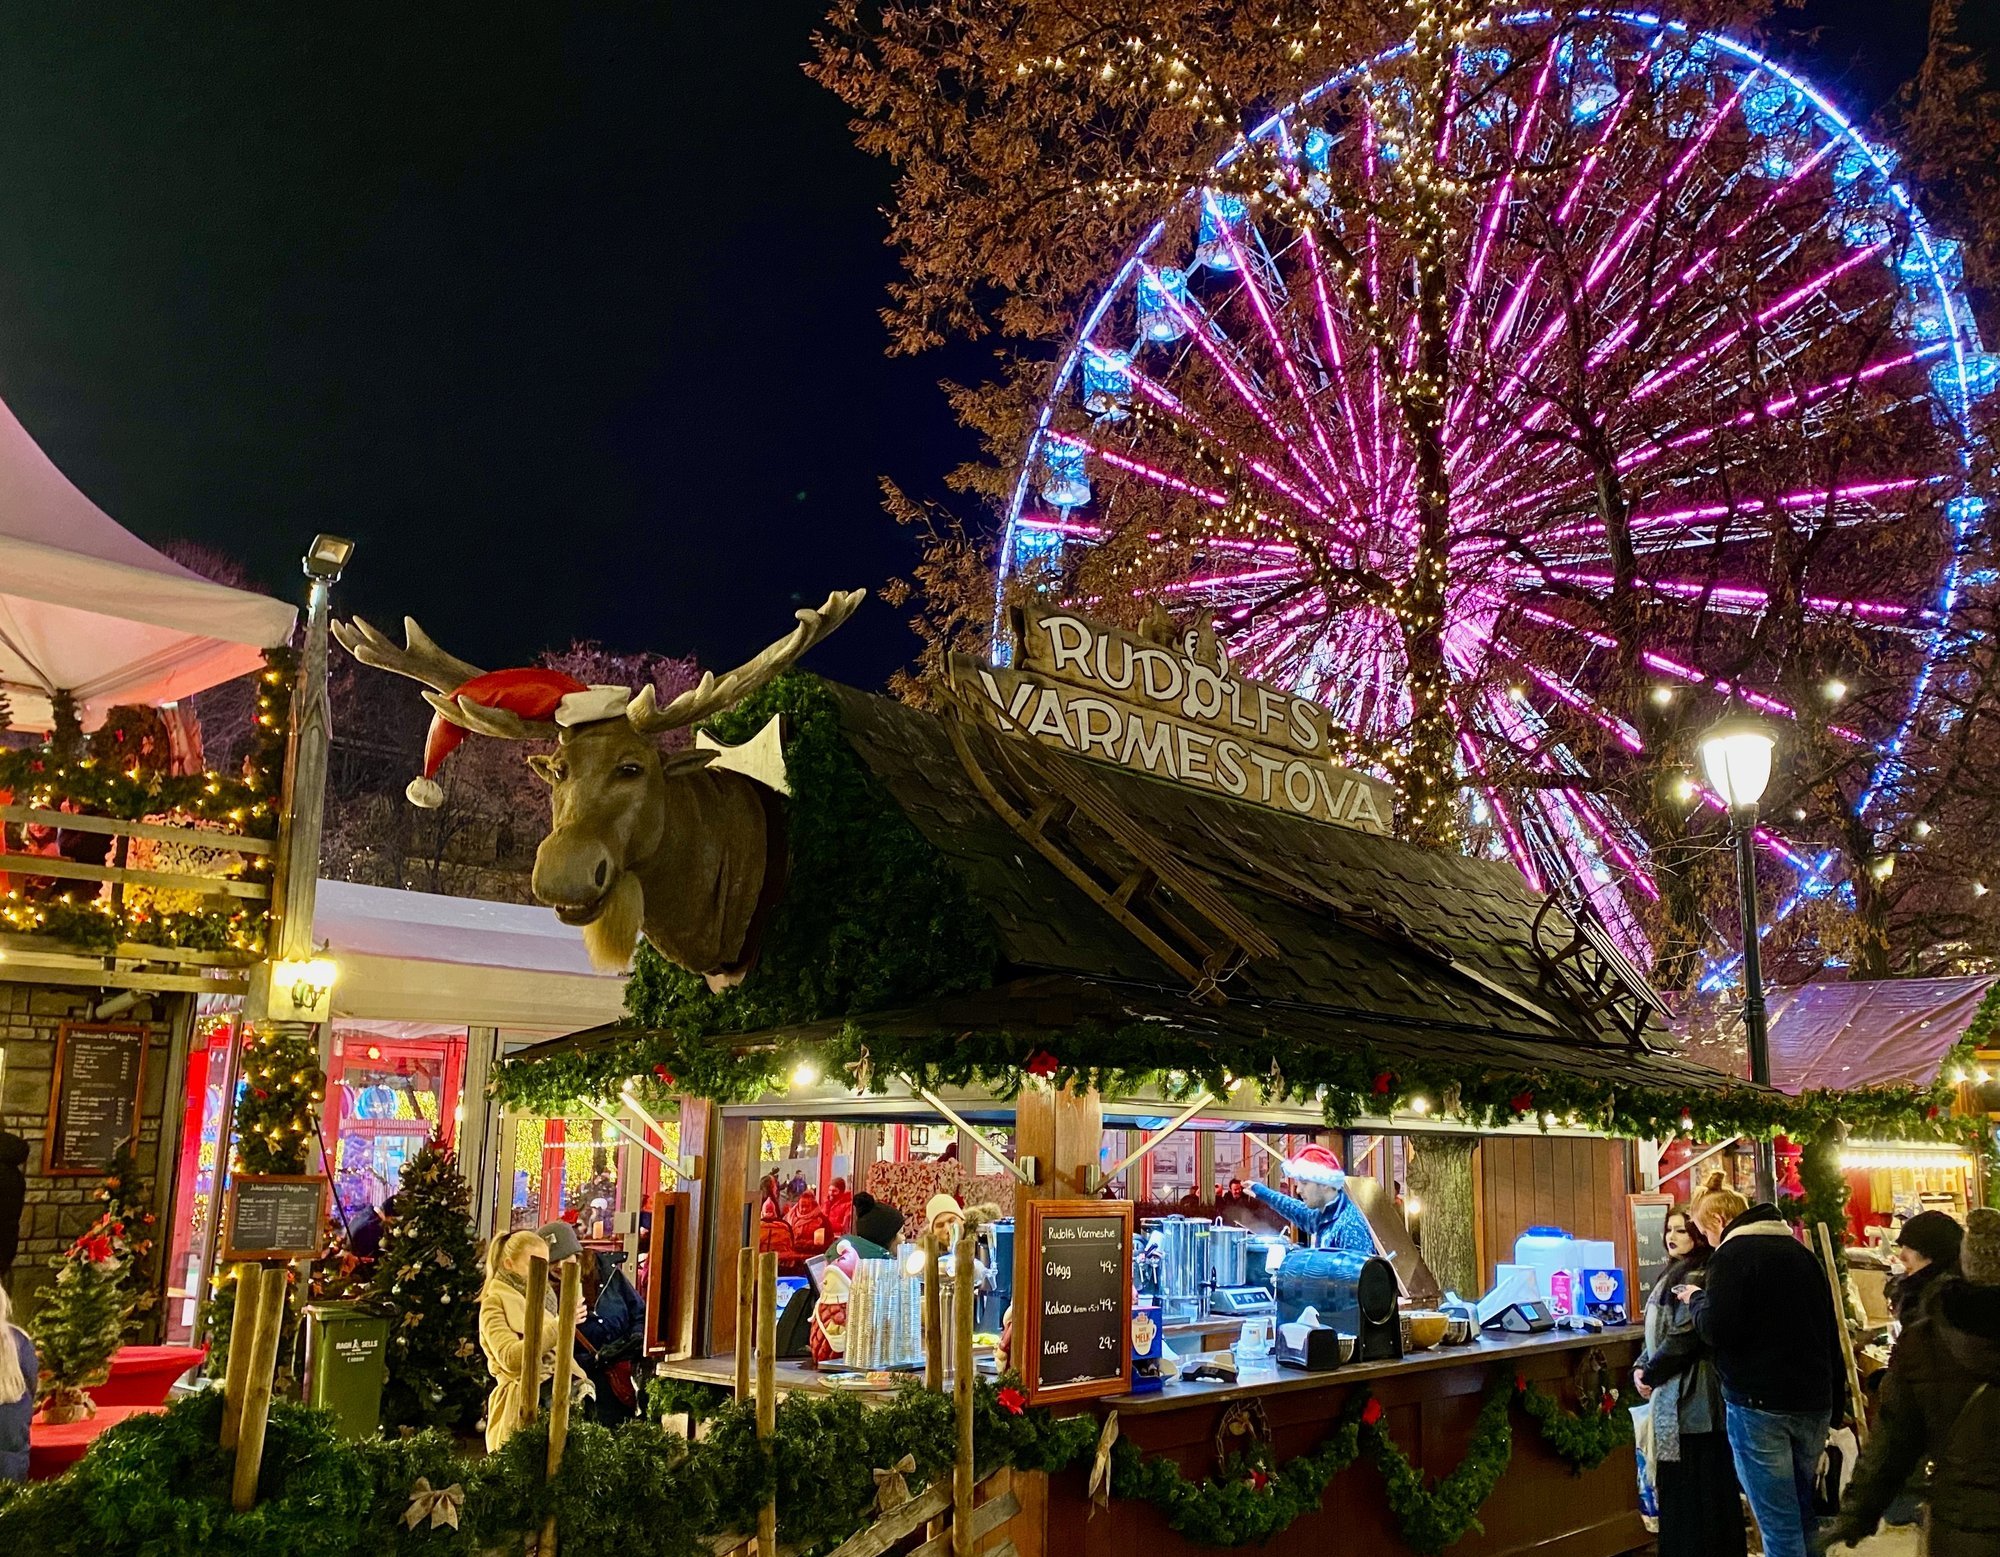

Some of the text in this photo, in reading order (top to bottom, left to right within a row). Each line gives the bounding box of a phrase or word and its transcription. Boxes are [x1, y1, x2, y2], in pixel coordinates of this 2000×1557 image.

[1037, 615, 1320, 750] RUDOLFS
[977, 669, 1386, 832] VARMESTOVA
[1048, 1226, 1116, 1240] Rudolfs Varmestue
[1045, 1260, 1117, 1280] Gløgg 49,-
[1045, 1301, 1072, 1316] Kakao
[1099, 1298, 1117, 1313] 49,-
[1044, 1336, 1116, 1355] Kaffe 29,-
[1135, 1333, 1150, 1343] MELK
